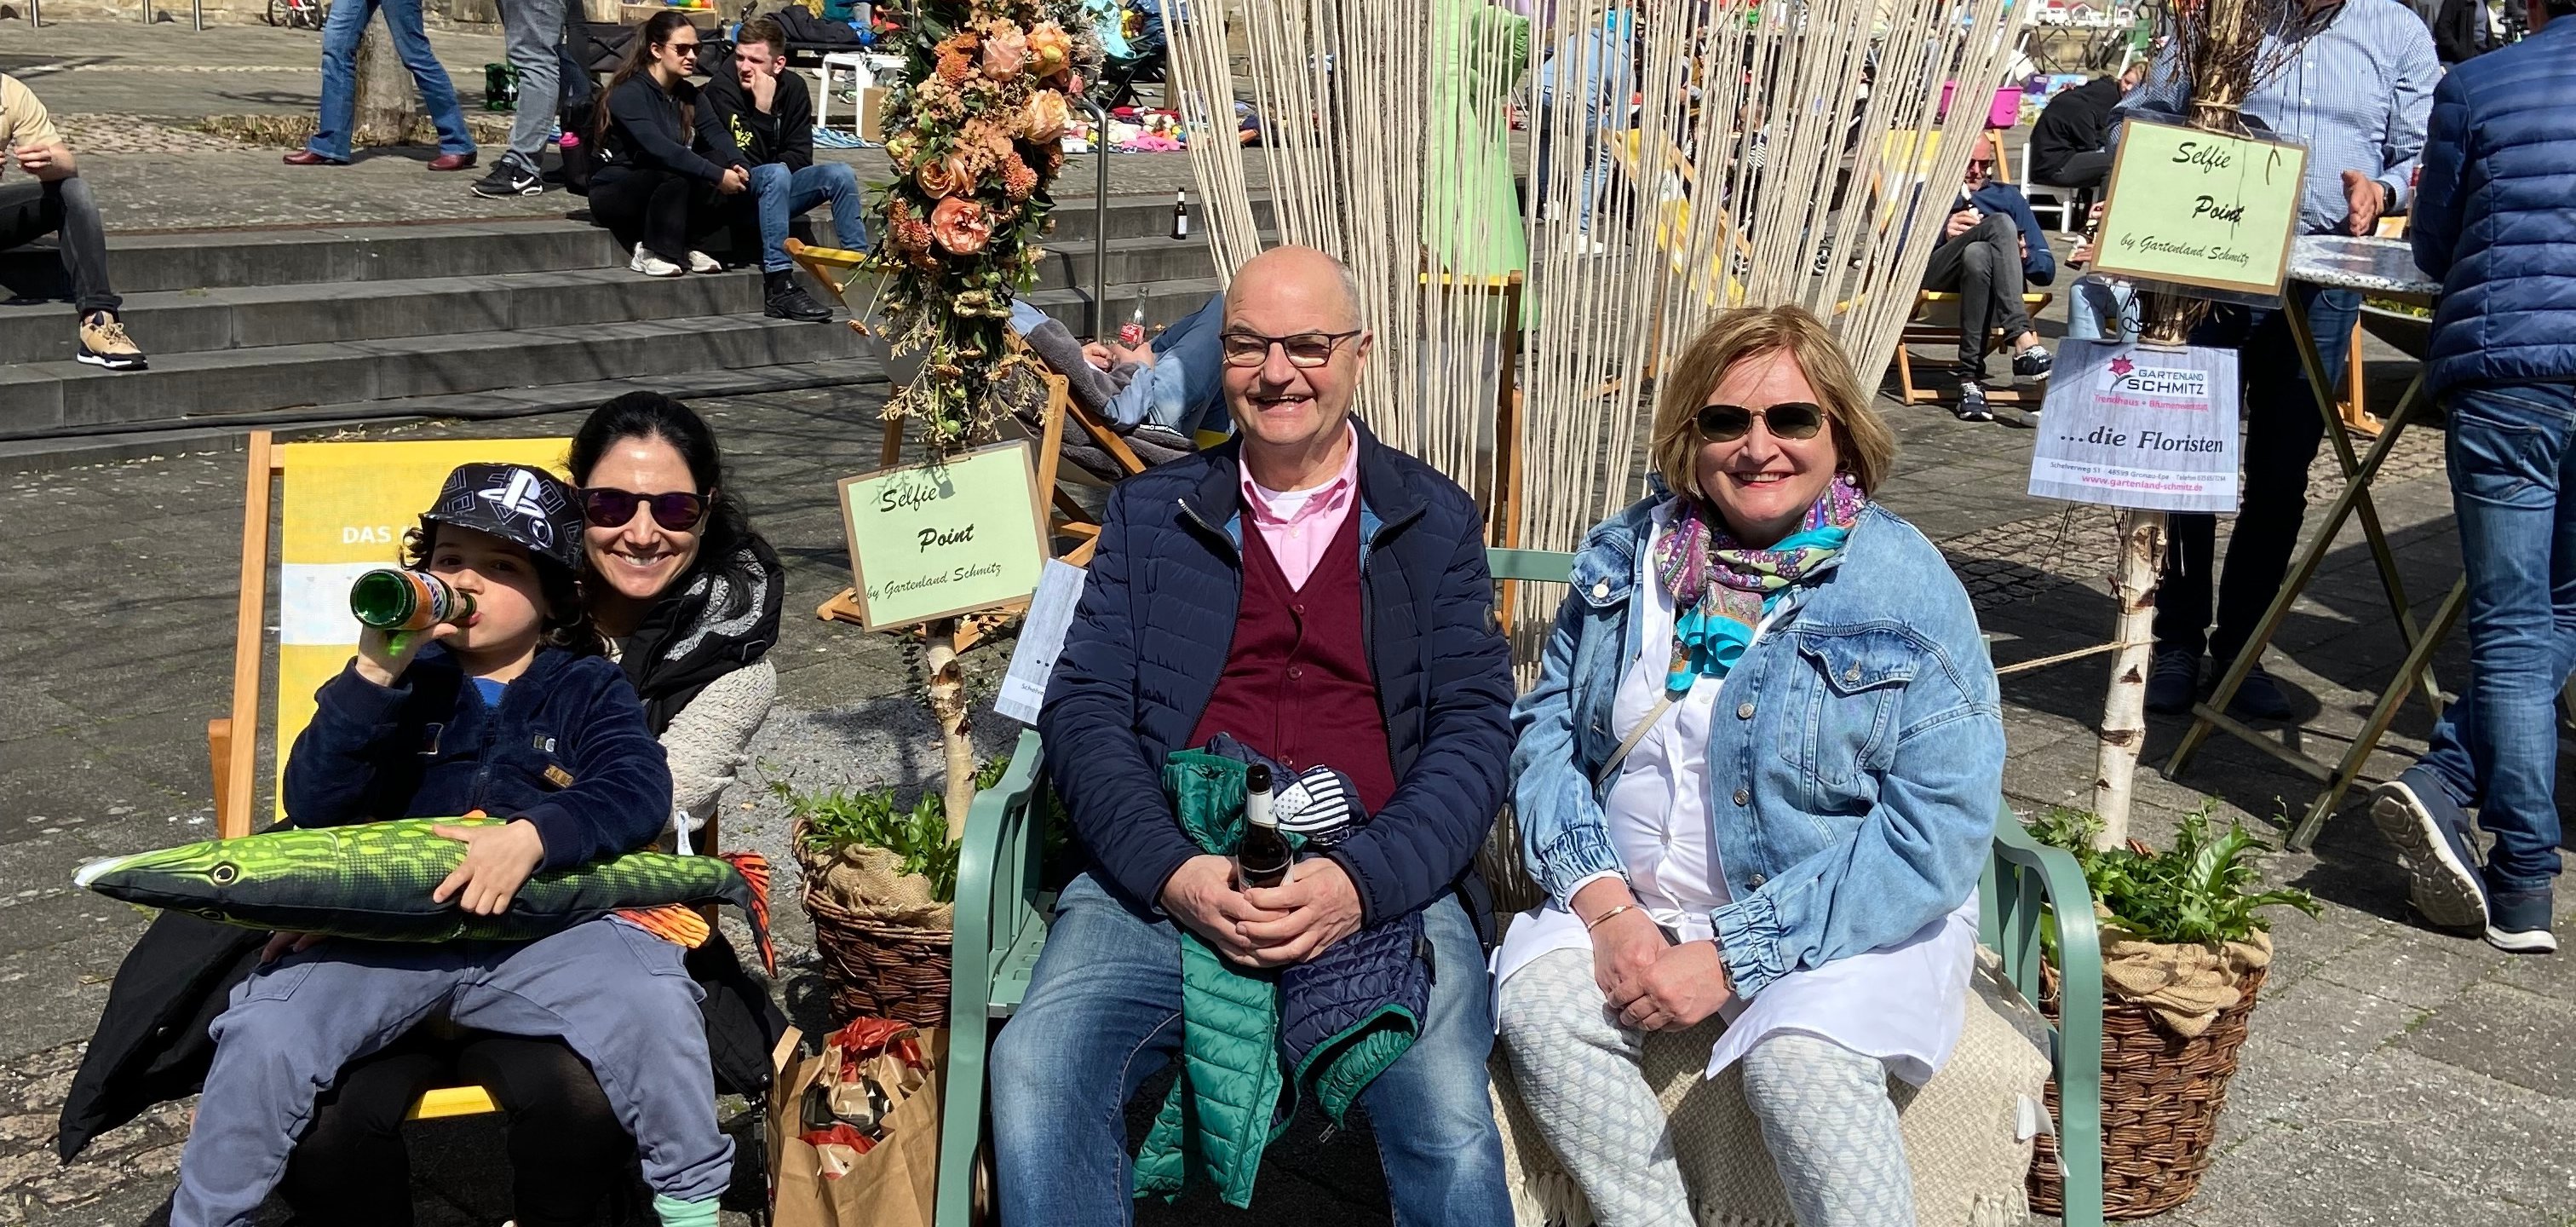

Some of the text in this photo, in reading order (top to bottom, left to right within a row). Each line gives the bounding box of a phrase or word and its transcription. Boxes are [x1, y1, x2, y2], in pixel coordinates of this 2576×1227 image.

[2172, 141, 2231, 175] Selfie
[2192, 195, 2245, 223] Point
[2120, 233, 2250, 268] by Gartenland Schmitz
[2126, 378, 2204, 395] SCHMITZ
[2138, 369, 2204, 382] GARTENLAND
[2094, 394, 2139, 406] Trendhaus
[2136, 429, 2223, 453] Floristen
[2082, 475, 2203, 492] www.gartenland-schmitz.de
[880, 483, 937, 512] Selfie
[342, 525, 392, 544] DAS
[917, 523, 975, 553] Point
[866, 562, 1002, 602] by Gartenland Schmitz
